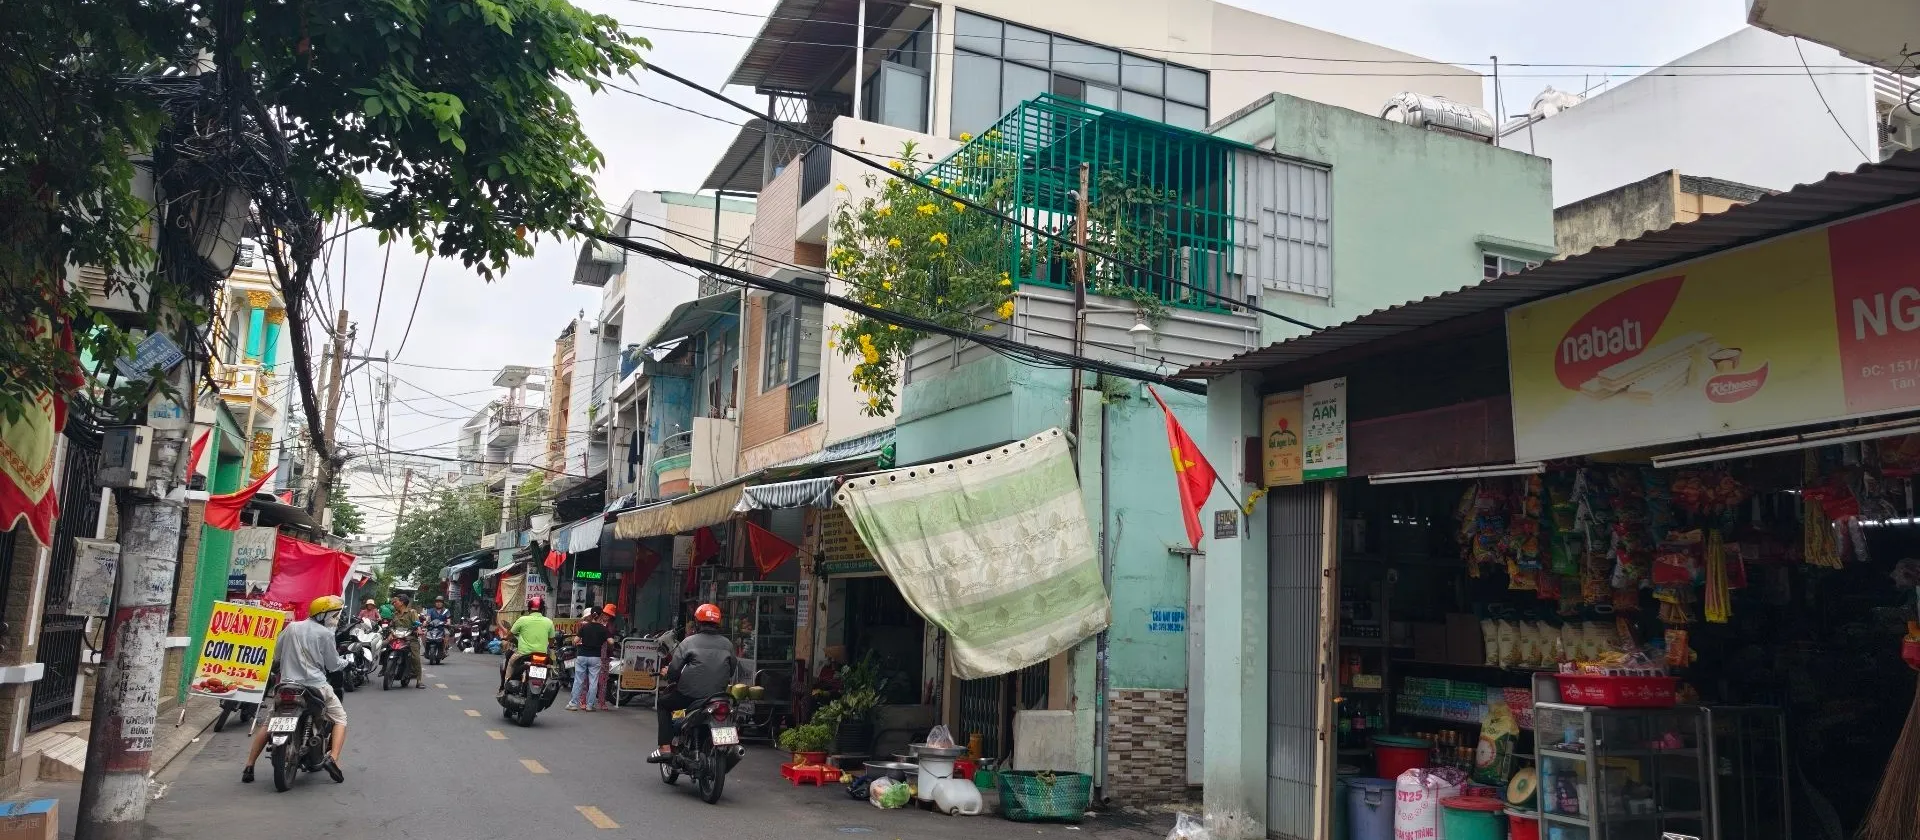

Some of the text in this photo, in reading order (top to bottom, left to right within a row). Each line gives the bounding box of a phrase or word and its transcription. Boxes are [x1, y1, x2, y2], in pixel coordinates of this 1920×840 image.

[1563, 318, 1642, 364] nabati
[1890, 358, 1920, 373] 151/
[210, 608, 278, 640] QUÁN 151
[204, 640, 267, 666] CƠM TRƯA
[202, 662, 260, 681] 30-35K
[1398, 789, 1422, 802] ST25
